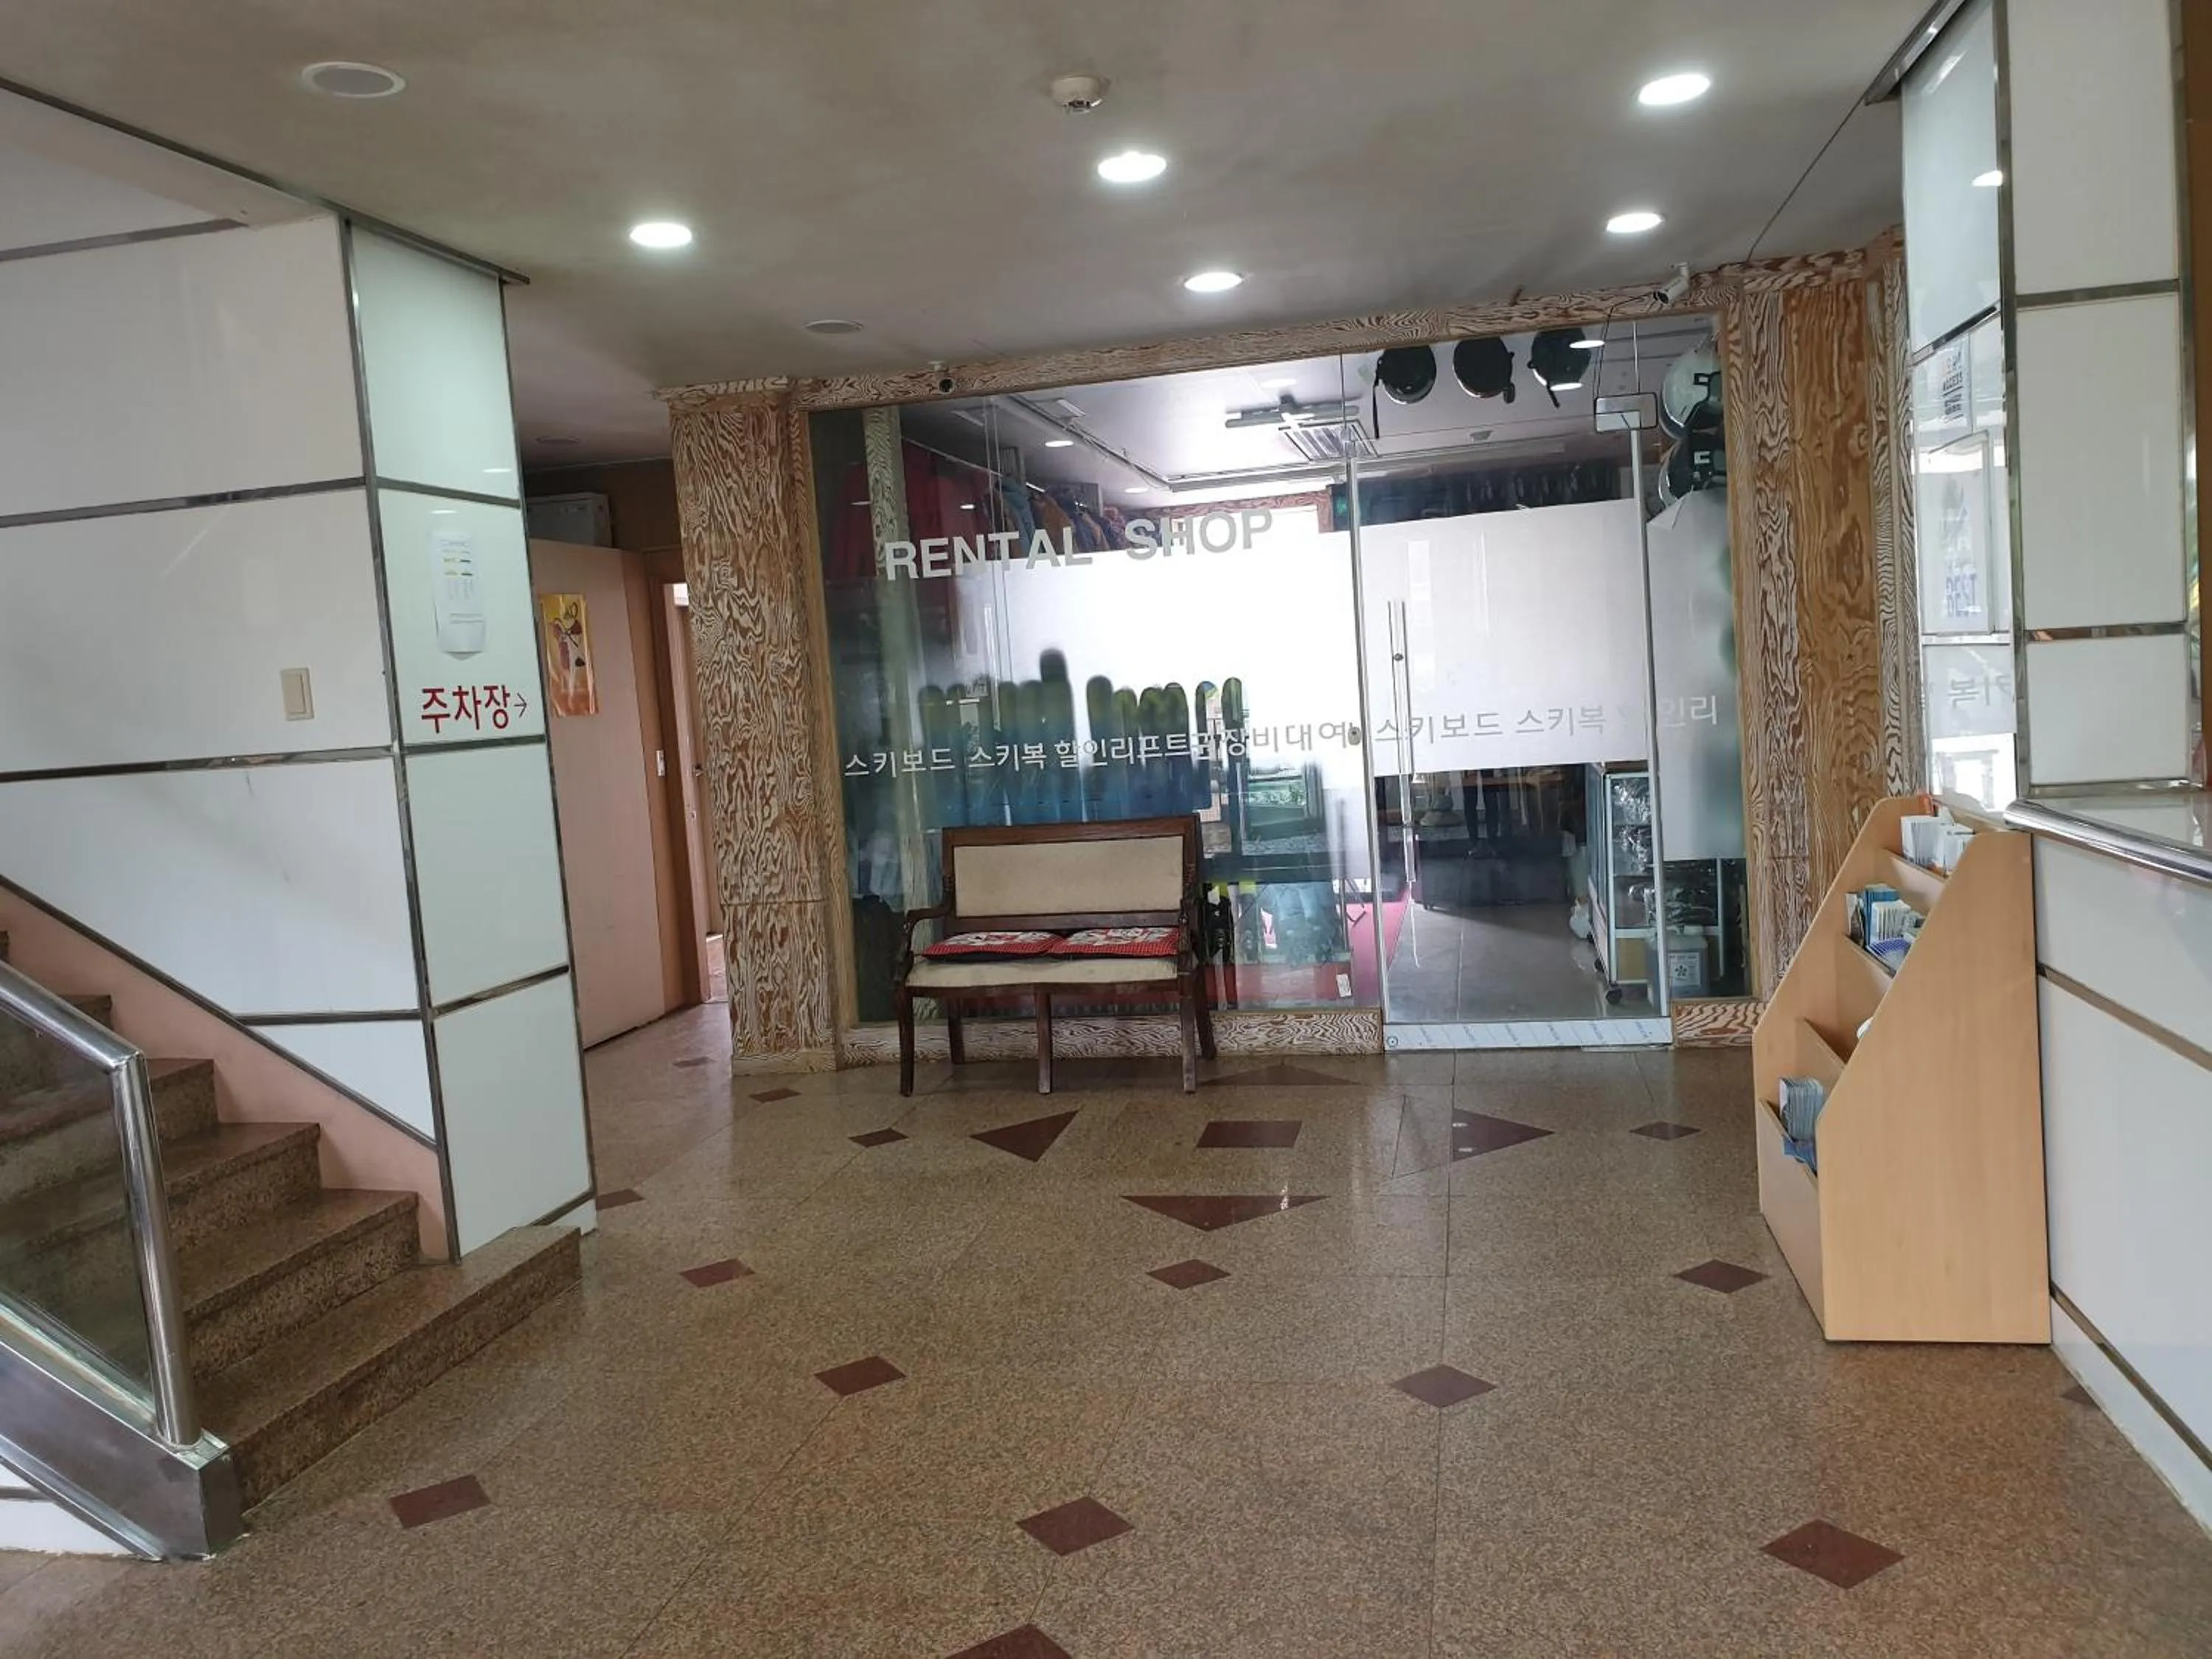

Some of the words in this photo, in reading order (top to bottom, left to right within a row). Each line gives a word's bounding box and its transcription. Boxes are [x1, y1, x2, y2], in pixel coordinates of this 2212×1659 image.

[885, 526, 1093, 581] RENTAL
[1124, 509, 1273, 560] SHOP
[421, 684, 510, 734] 주차장
[1374, 712, 1503, 743] 스키보드
[1515, 705, 1607, 736] 스키복
[844, 748, 956, 778] 스키보드
[968, 742, 1047, 771] 스키복
